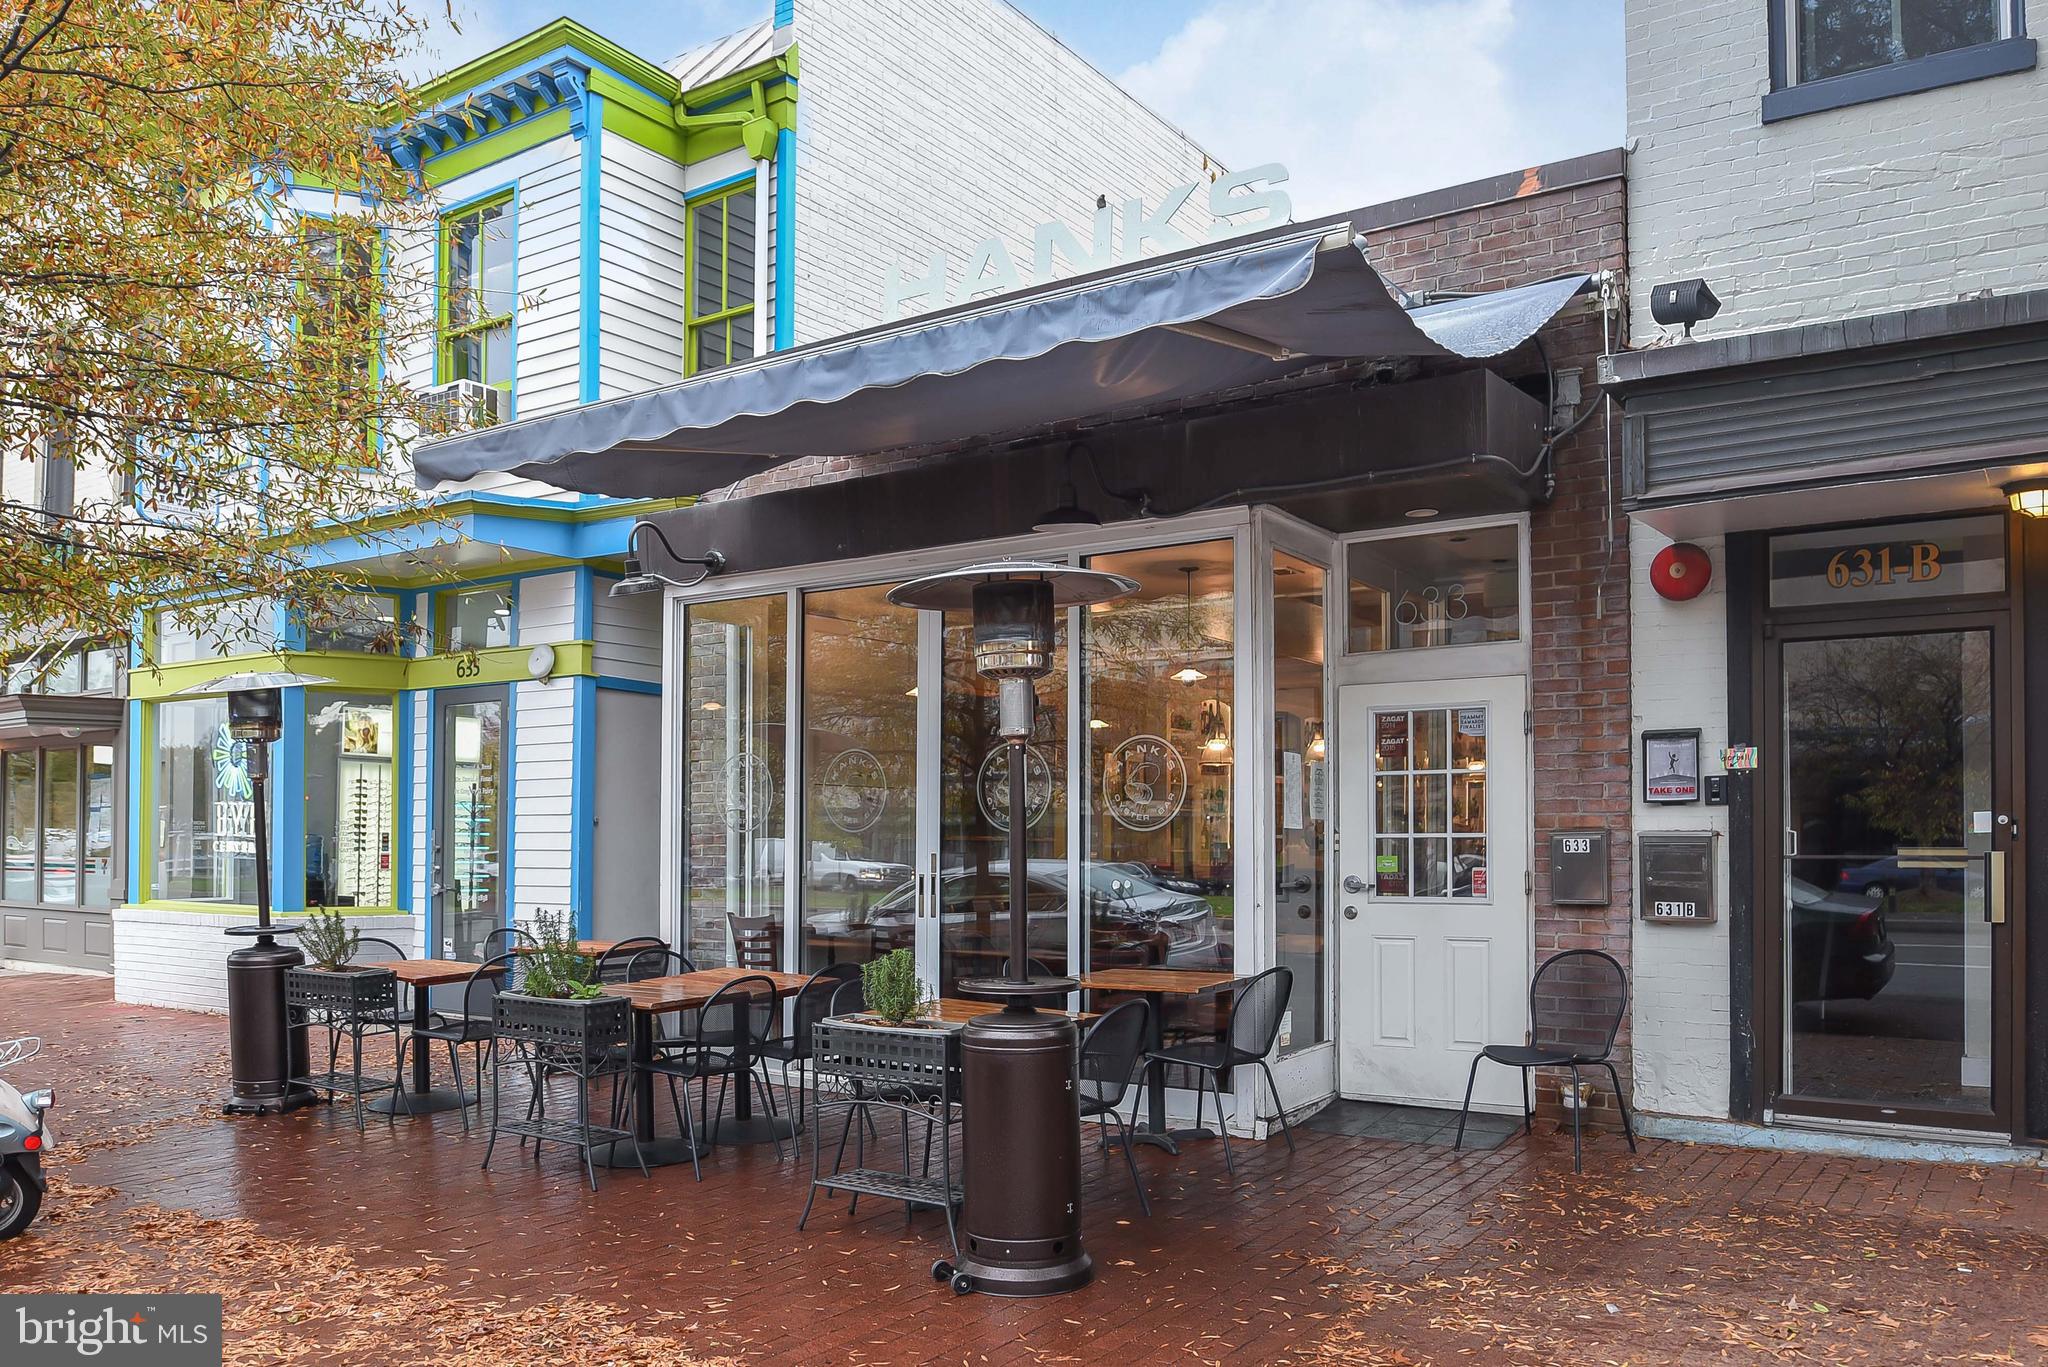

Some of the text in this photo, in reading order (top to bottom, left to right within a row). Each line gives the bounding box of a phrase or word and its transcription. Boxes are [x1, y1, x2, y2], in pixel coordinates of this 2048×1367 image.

[1827, 543, 1942, 589] 631-B
[1394, 583, 1468, 625] 633
[457, 657, 480, 678] 635
[1117, 744, 1175, 773] HANK'S
[1648, 786, 1696, 795] TAKE ONE
[1114, 792, 1175, 821] OYSTER BAR
[1564, 840, 1588, 852] 633
